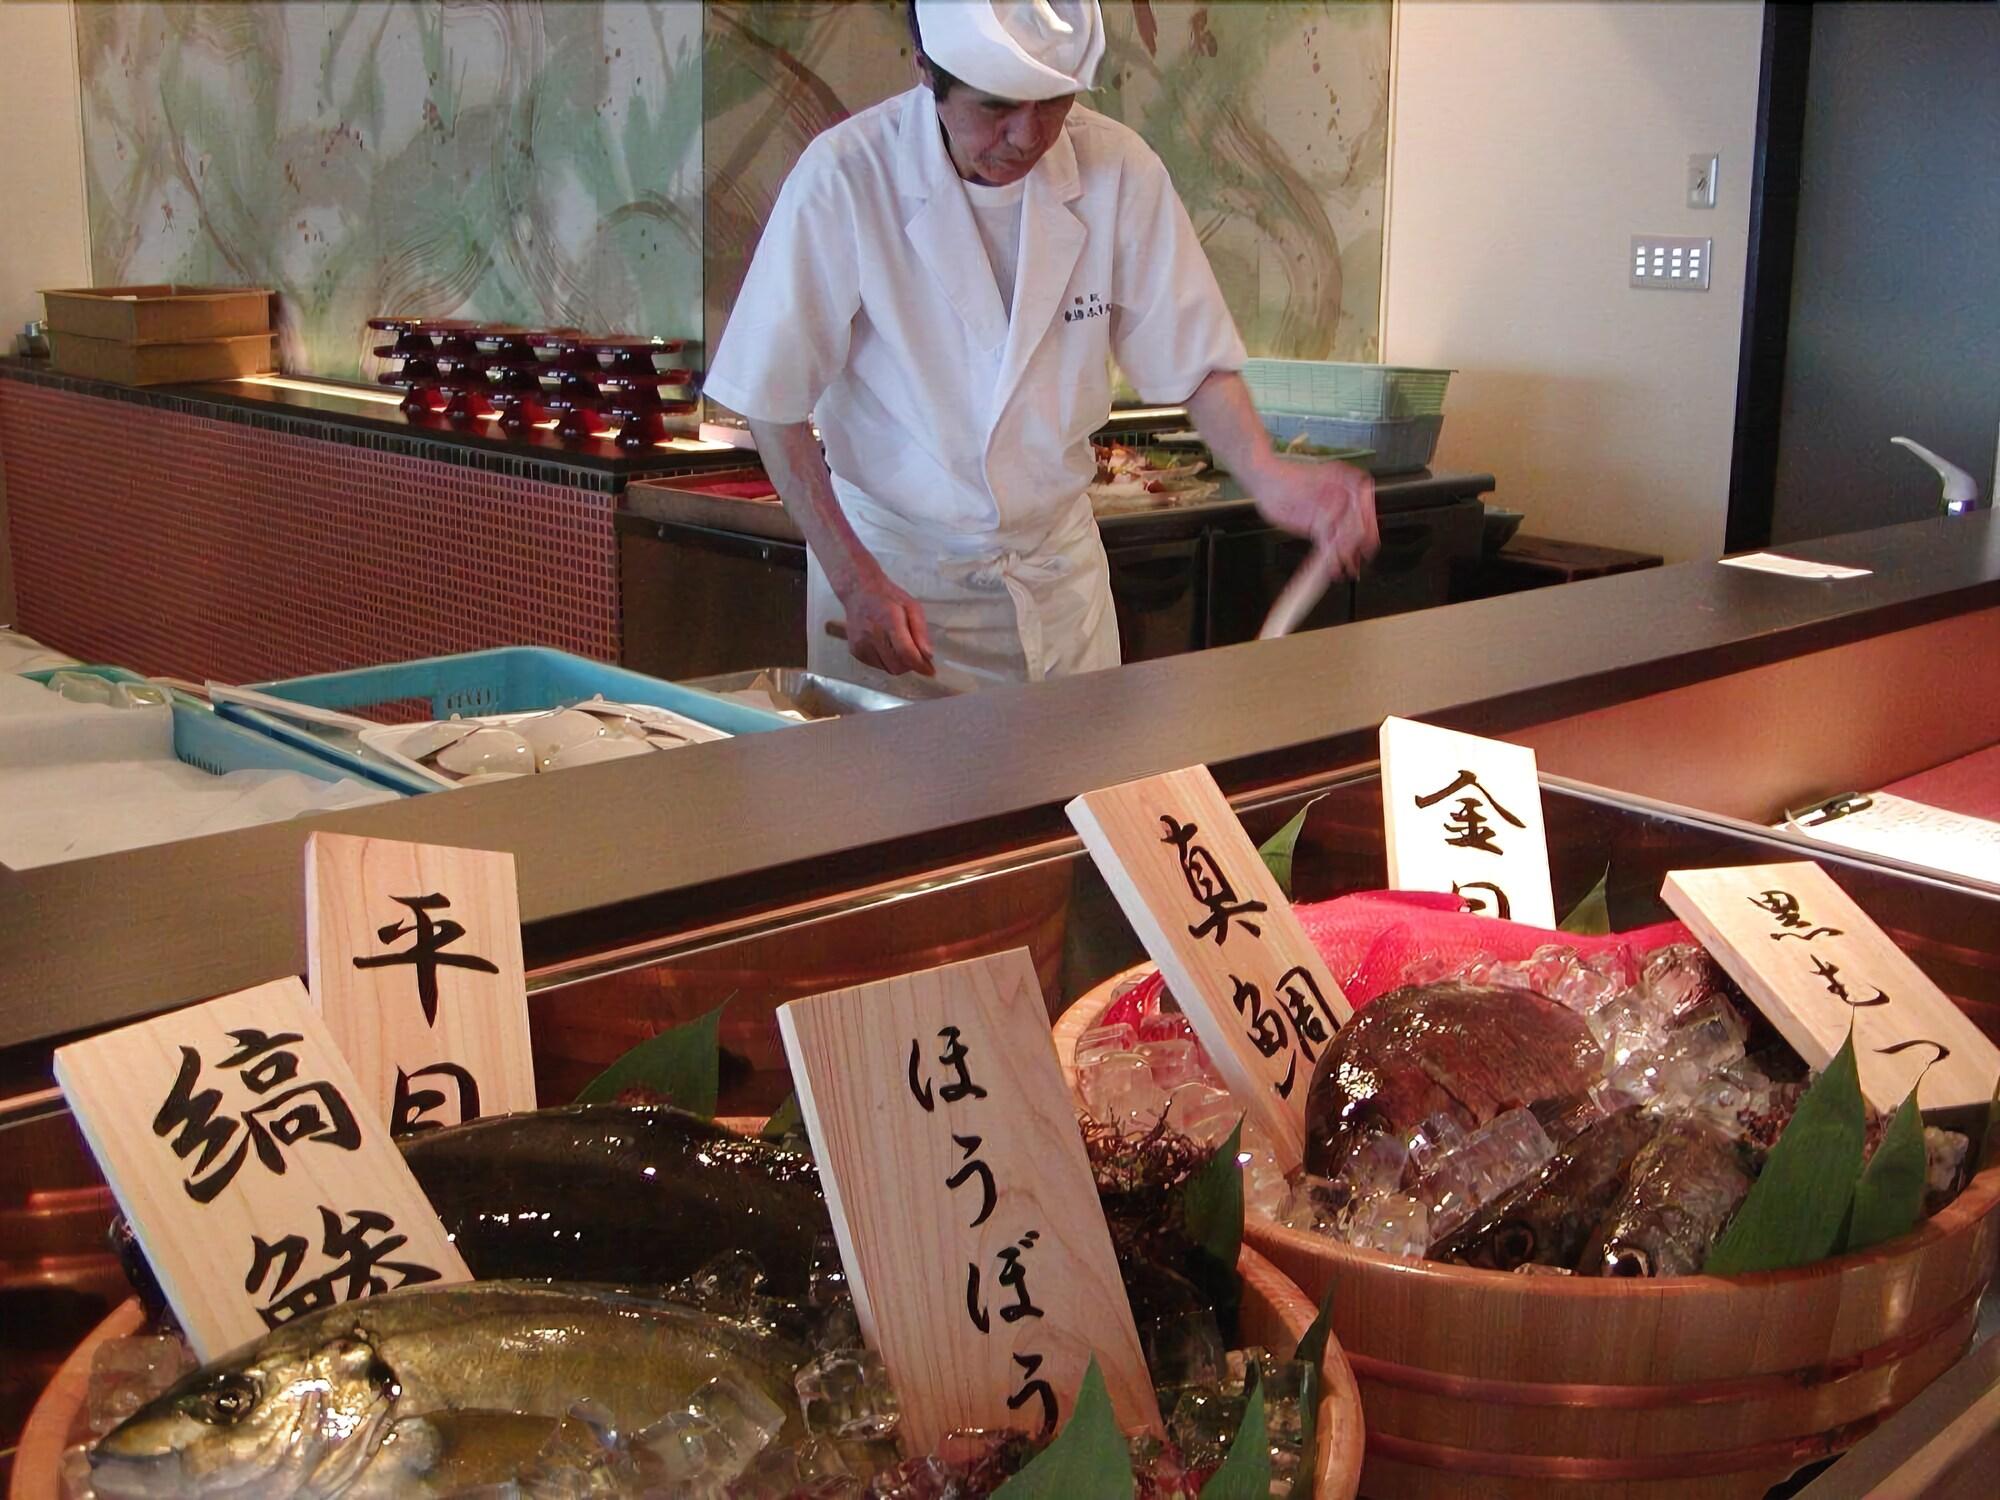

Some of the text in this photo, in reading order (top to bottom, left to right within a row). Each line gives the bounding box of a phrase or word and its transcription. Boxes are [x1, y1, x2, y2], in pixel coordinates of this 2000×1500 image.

[353, 892, 499, 1136] 平目
[1160, 814, 1341, 1099] 真鯛
[908, 1025, 1060, 1438] ほうぼう
